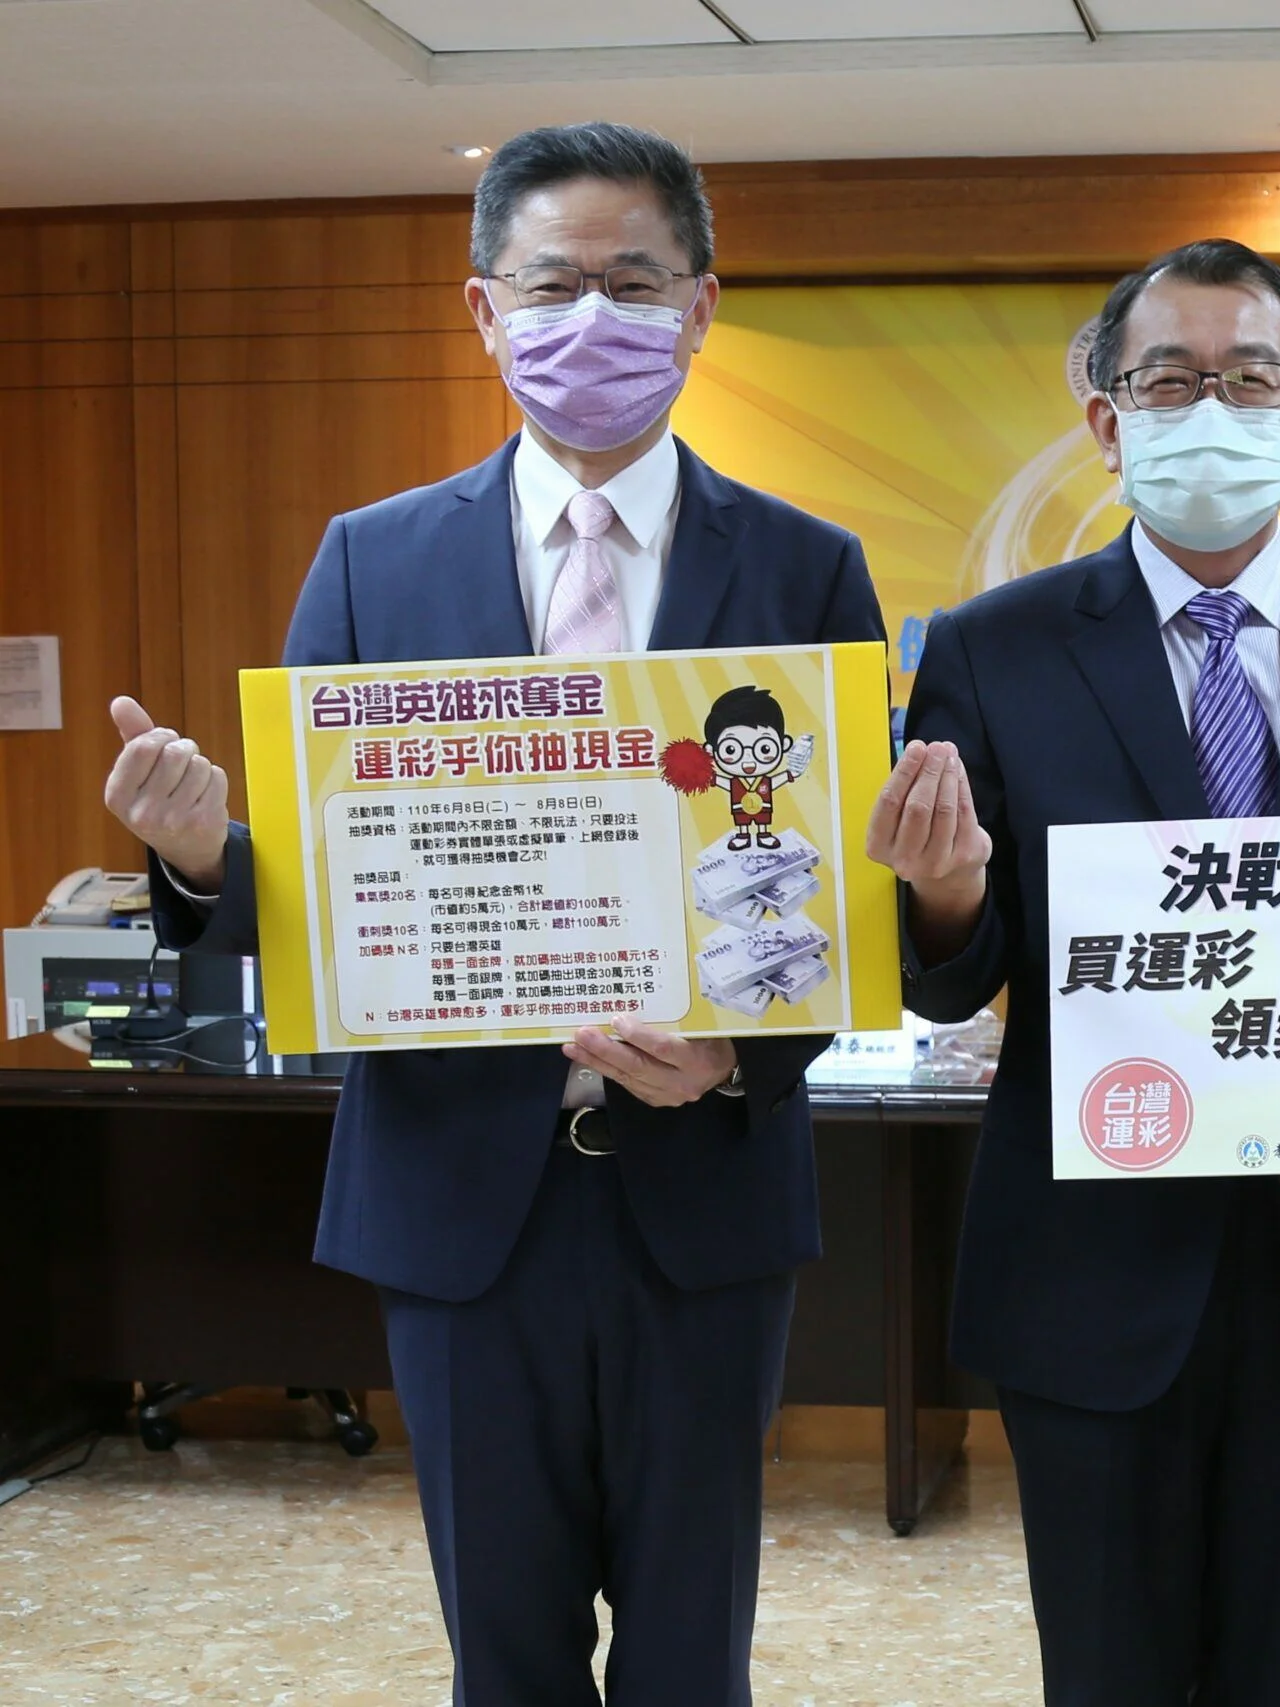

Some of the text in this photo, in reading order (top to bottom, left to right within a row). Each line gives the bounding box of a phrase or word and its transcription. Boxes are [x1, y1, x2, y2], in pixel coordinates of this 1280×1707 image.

[312, 674, 604, 728] 台灣英雄來奪金
[354, 728, 656, 781] 運彩乎你抽現金
[1058, 929, 1257, 995] 買運彩
[1103, 1080, 1172, 1115] 台灣
[1101, 1115, 1172, 1149] 運彩
